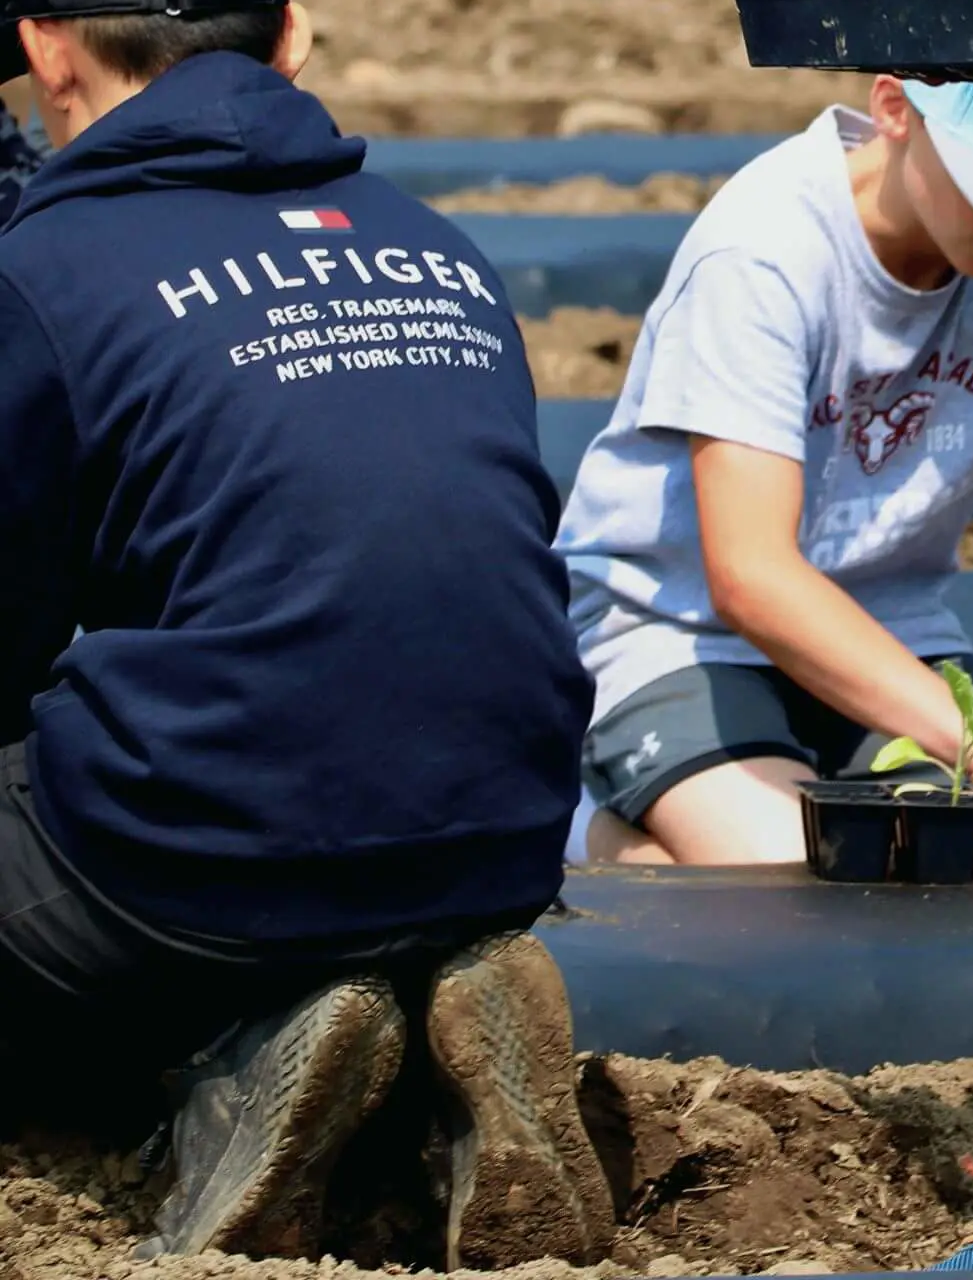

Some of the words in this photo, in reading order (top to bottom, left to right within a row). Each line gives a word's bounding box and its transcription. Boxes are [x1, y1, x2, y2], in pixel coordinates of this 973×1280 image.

[157, 248, 497, 319] HILFIGER
[266, 302, 327, 327] REG.
[328, 298, 466, 320] TRADEMARK
[229, 322, 398, 367] ESTABLISHED
[276, 353, 333, 383] NEW
[337, 347, 403, 371] YORK
